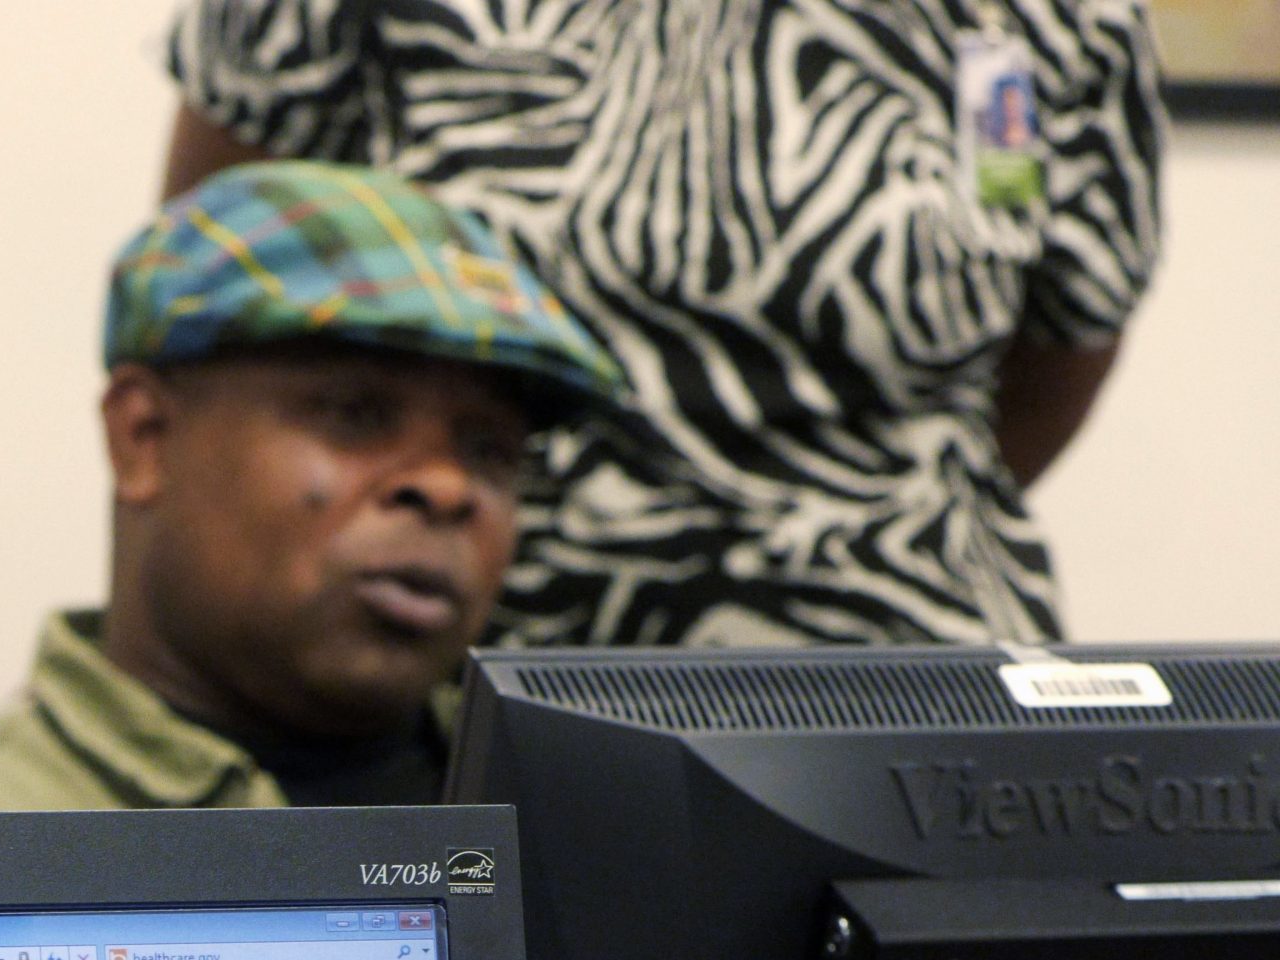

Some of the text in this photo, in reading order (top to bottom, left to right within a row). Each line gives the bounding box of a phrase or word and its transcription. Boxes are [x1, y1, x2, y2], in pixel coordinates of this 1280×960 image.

[888, 755, 1280, 838] ViewSoni
[360, 861, 441, 886] VA703b
[450, 886, 493, 894] ENERGY STAR
